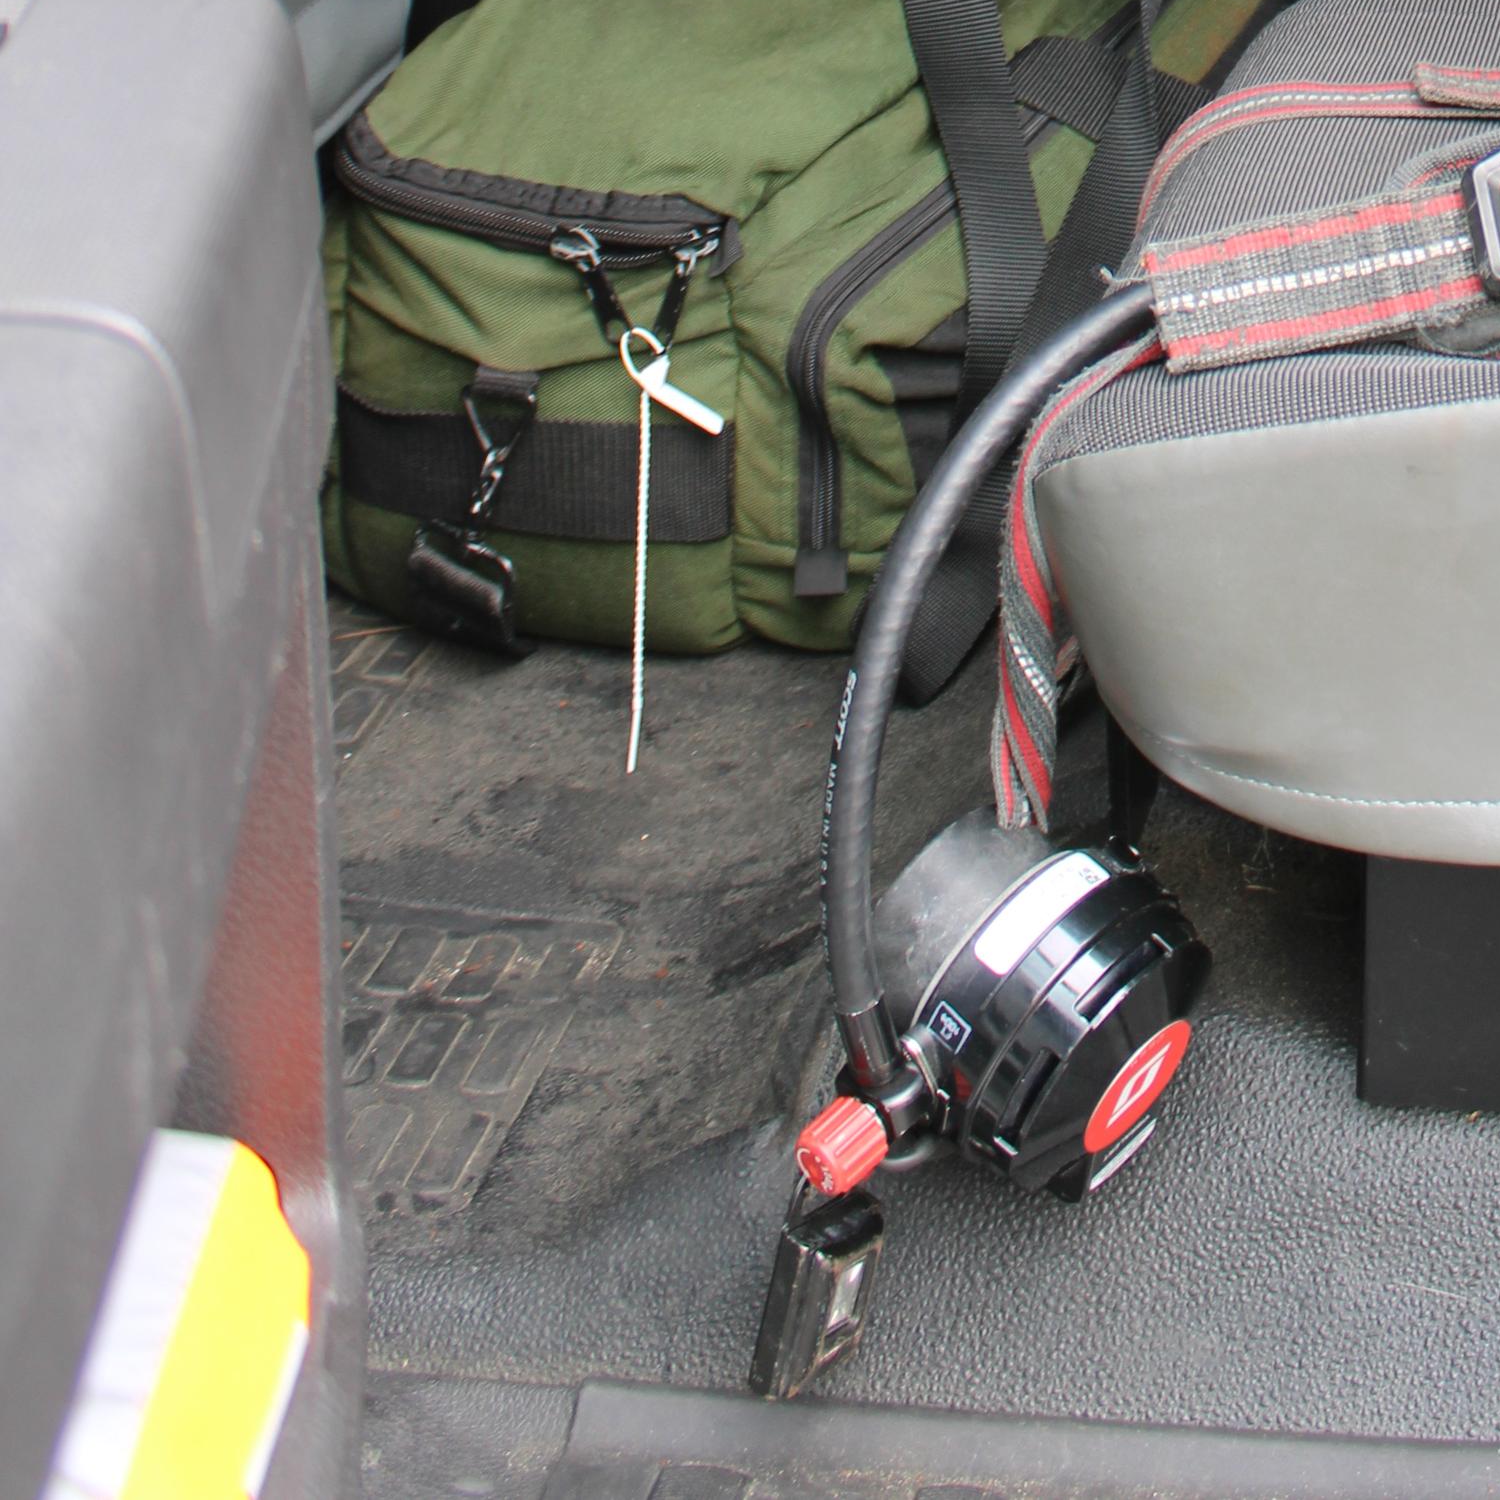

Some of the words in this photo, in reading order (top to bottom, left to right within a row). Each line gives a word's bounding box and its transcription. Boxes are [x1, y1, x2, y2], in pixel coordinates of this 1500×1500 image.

[834, 669, 858, 750] SCOTT
[825, 762, 838, 815] MADE
[821, 818, 831, 838] IN
